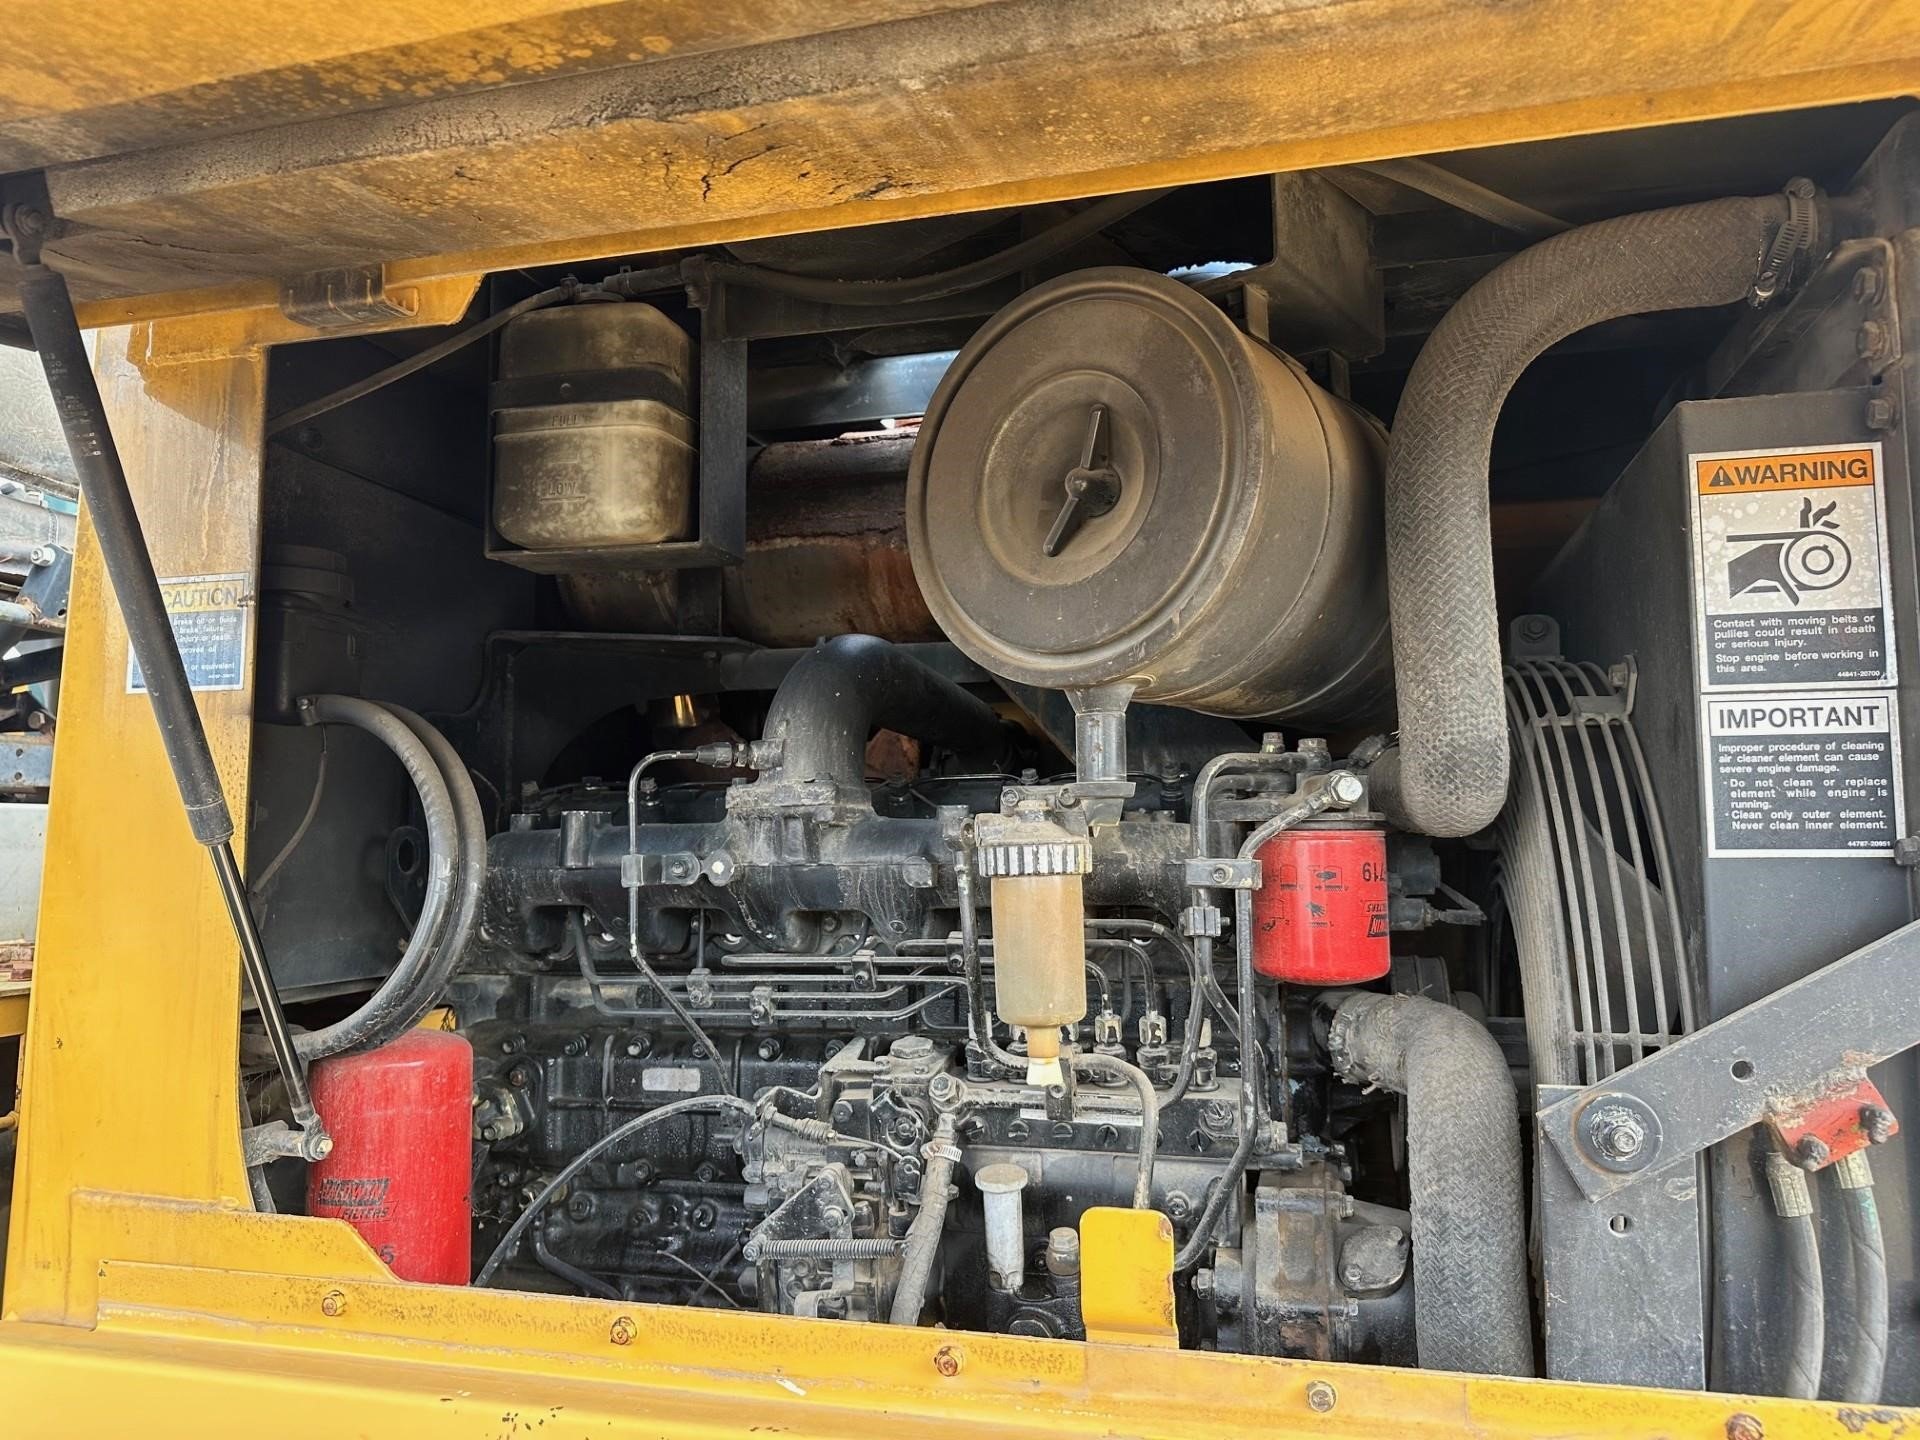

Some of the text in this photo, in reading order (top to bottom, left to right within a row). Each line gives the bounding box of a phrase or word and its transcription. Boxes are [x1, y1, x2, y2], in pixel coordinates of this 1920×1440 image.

[1734, 458, 1868, 486] WARNING
[547, 481, 577, 496] LOW
[1714, 614, 1876, 629] Contact with moving belts or
[1714, 624, 1876, 640] pullies could result in death
[1715, 637, 1808, 649] or serious injury.
[1715, 649, 1879, 665] Stop engine before working in
[1716, 663, 1767, 673] this area.
[1719, 705, 1880, 729] IMPORTANT
[1718, 741, 1885, 754] Improper procedure of cleaning
[1718, 752, 1880, 763] air cleaner element can cause
[1719, 763, 1840, 775] severe engine damage.
[1729, 778, 1888, 788] Do not clean or replace
[1730, 788, 1888, 799] element while engine is
[1730, 800, 1773, 810] running.
[1731, 809, 1887, 820] Clean only outer element.
[1731, 820, 1888, 830] Never clean inner element.
[342, 1207, 390, 1219] FILTERS
